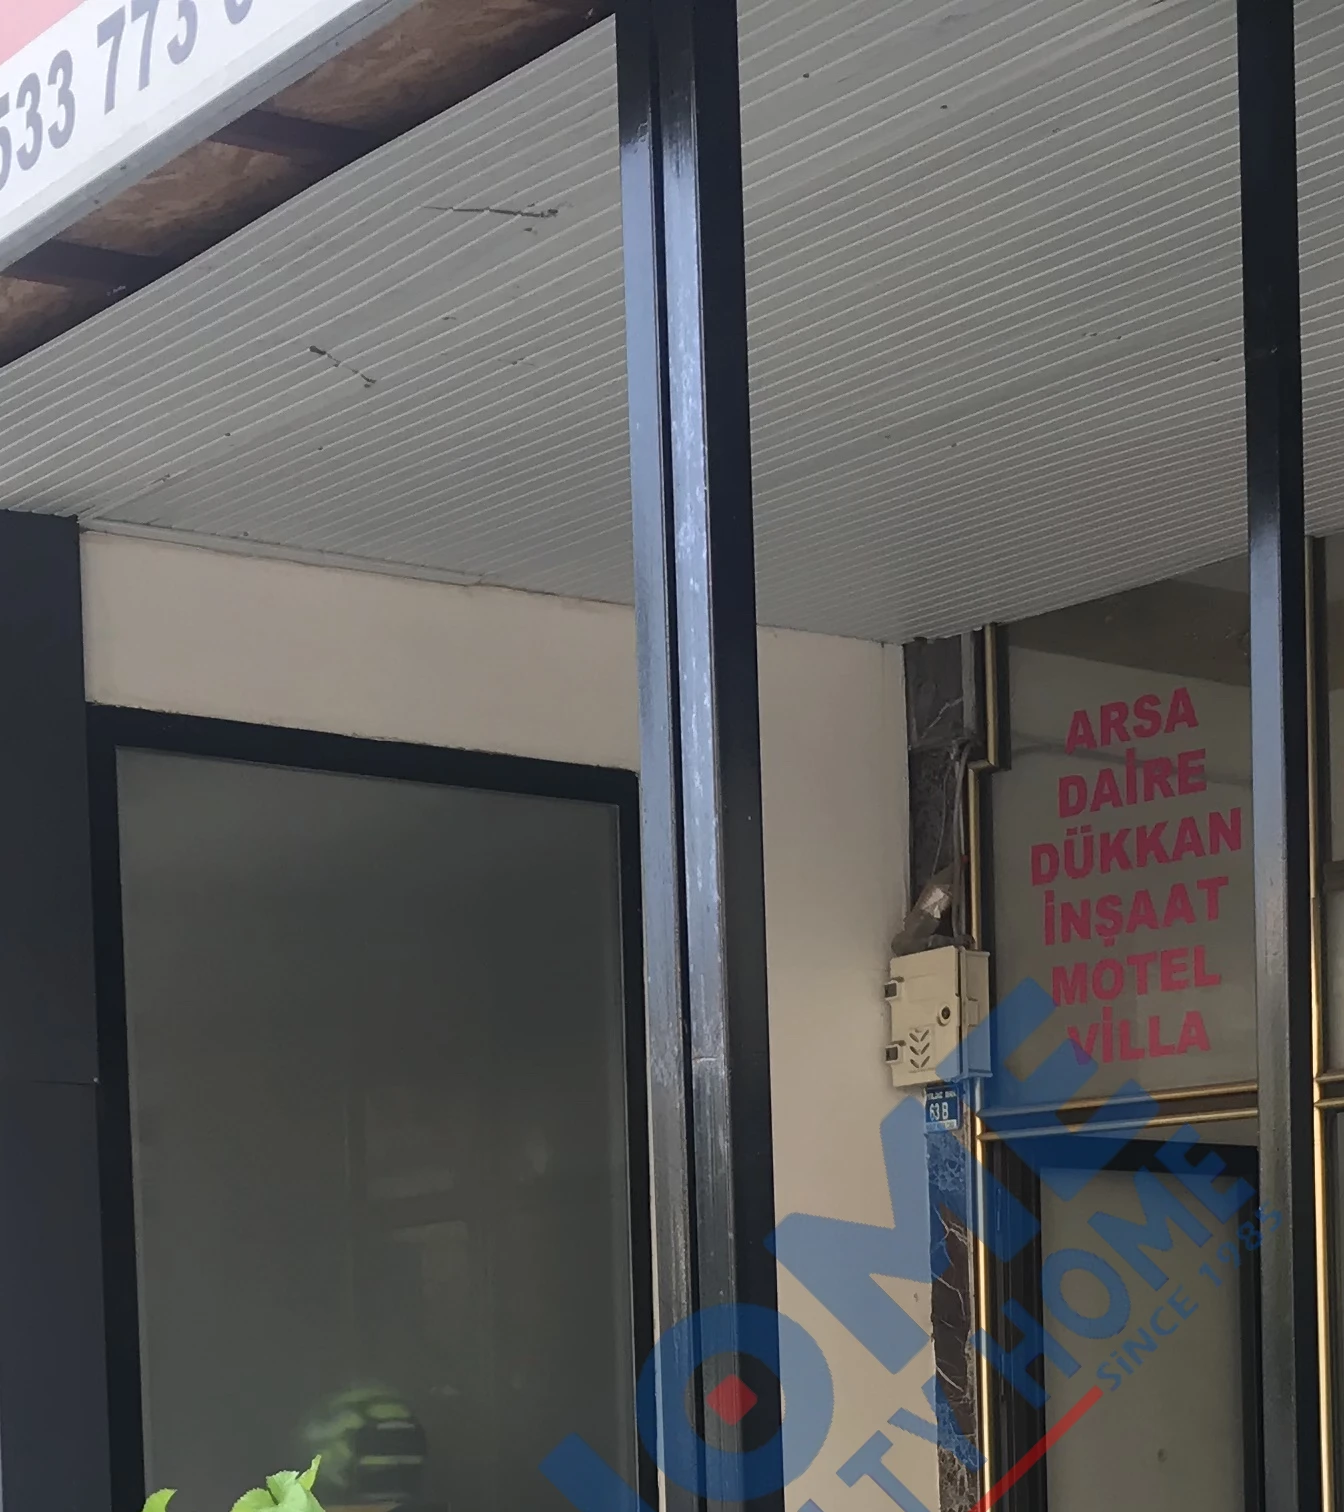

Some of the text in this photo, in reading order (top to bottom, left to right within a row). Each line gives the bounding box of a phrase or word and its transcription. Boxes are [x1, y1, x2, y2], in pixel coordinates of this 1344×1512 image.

[97, 0, 198, 116] 773
[1064, 687, 1199, 754] ARSA
[1057, 749, 1207, 819] DAİRE
[1030, 808, 1243, 886] DÜKKAN
[1043, 876, 1230, 947] İNŞAAT
[1051, 945, 1222, 1008] MOTEL
[1066, 1006, 1211, 1066] VİLLA
